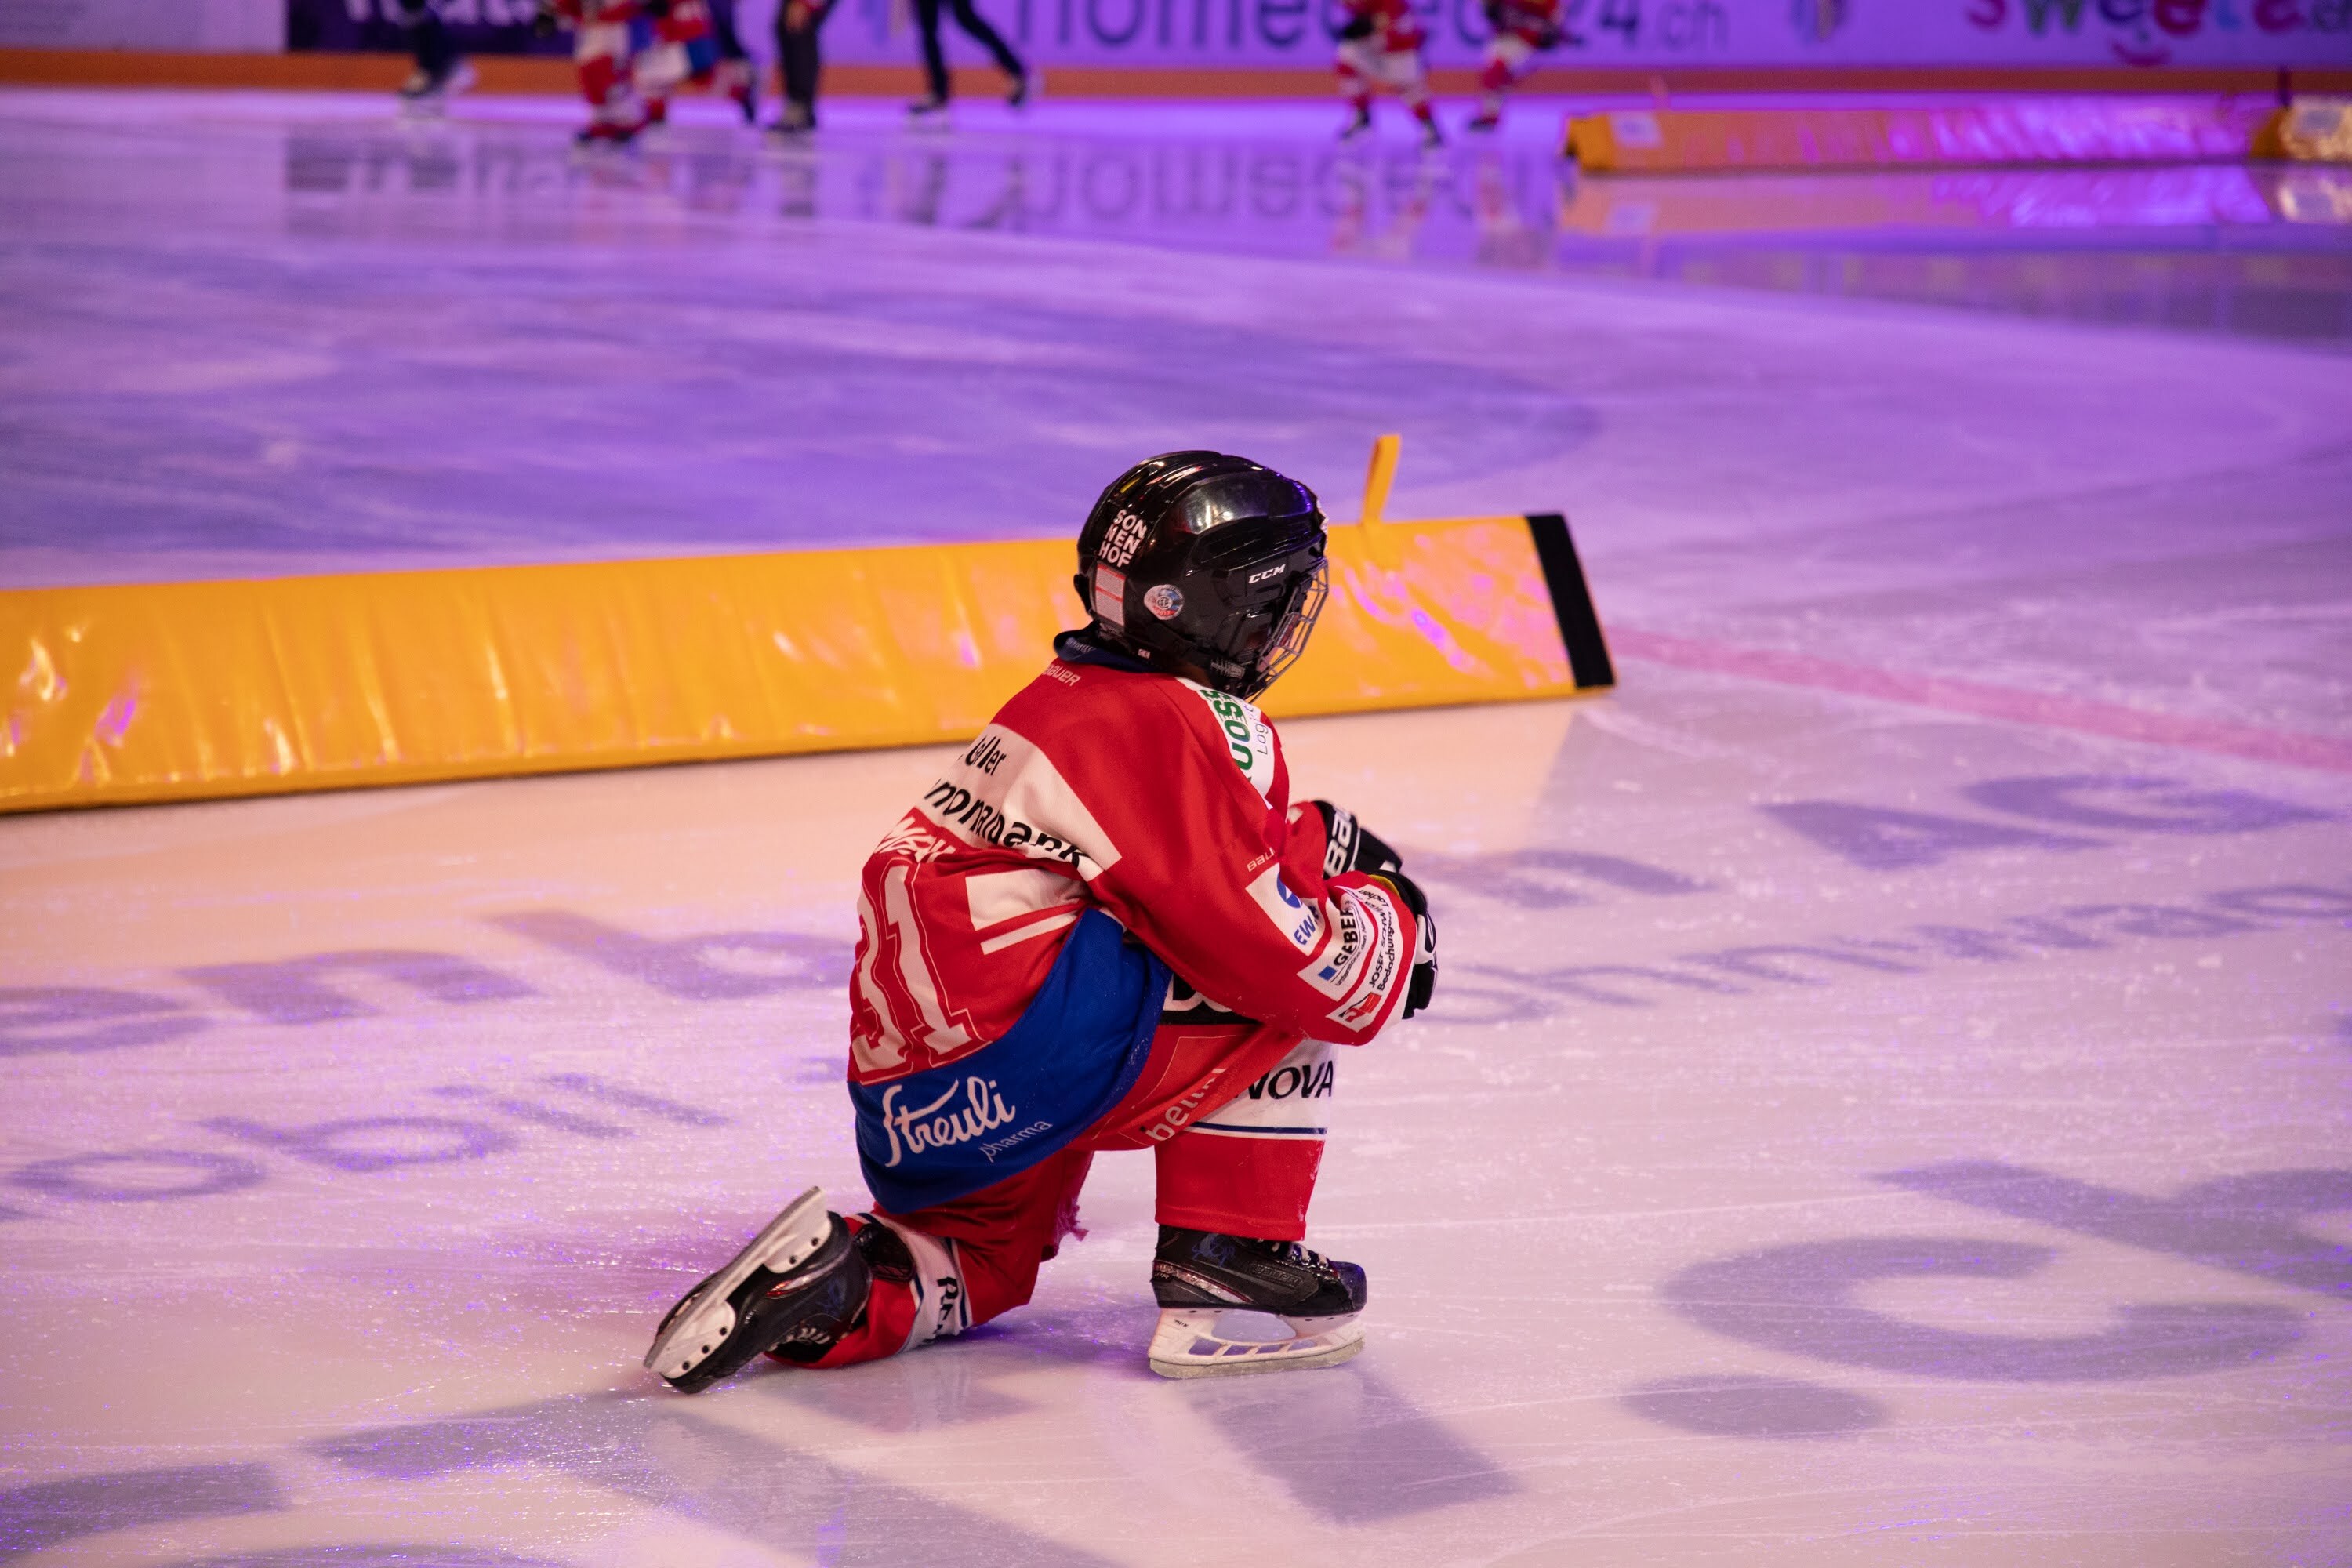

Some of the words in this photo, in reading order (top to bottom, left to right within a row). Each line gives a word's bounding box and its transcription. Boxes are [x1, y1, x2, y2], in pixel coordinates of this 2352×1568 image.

[1105, 524, 1141, 554] NEN
[1113, 509, 1147, 539] SON
[1098, 540, 1133, 568] HOF
[1248, 563, 1286, 584] CCM
[978, 1120, 1054, 1163] pharma
